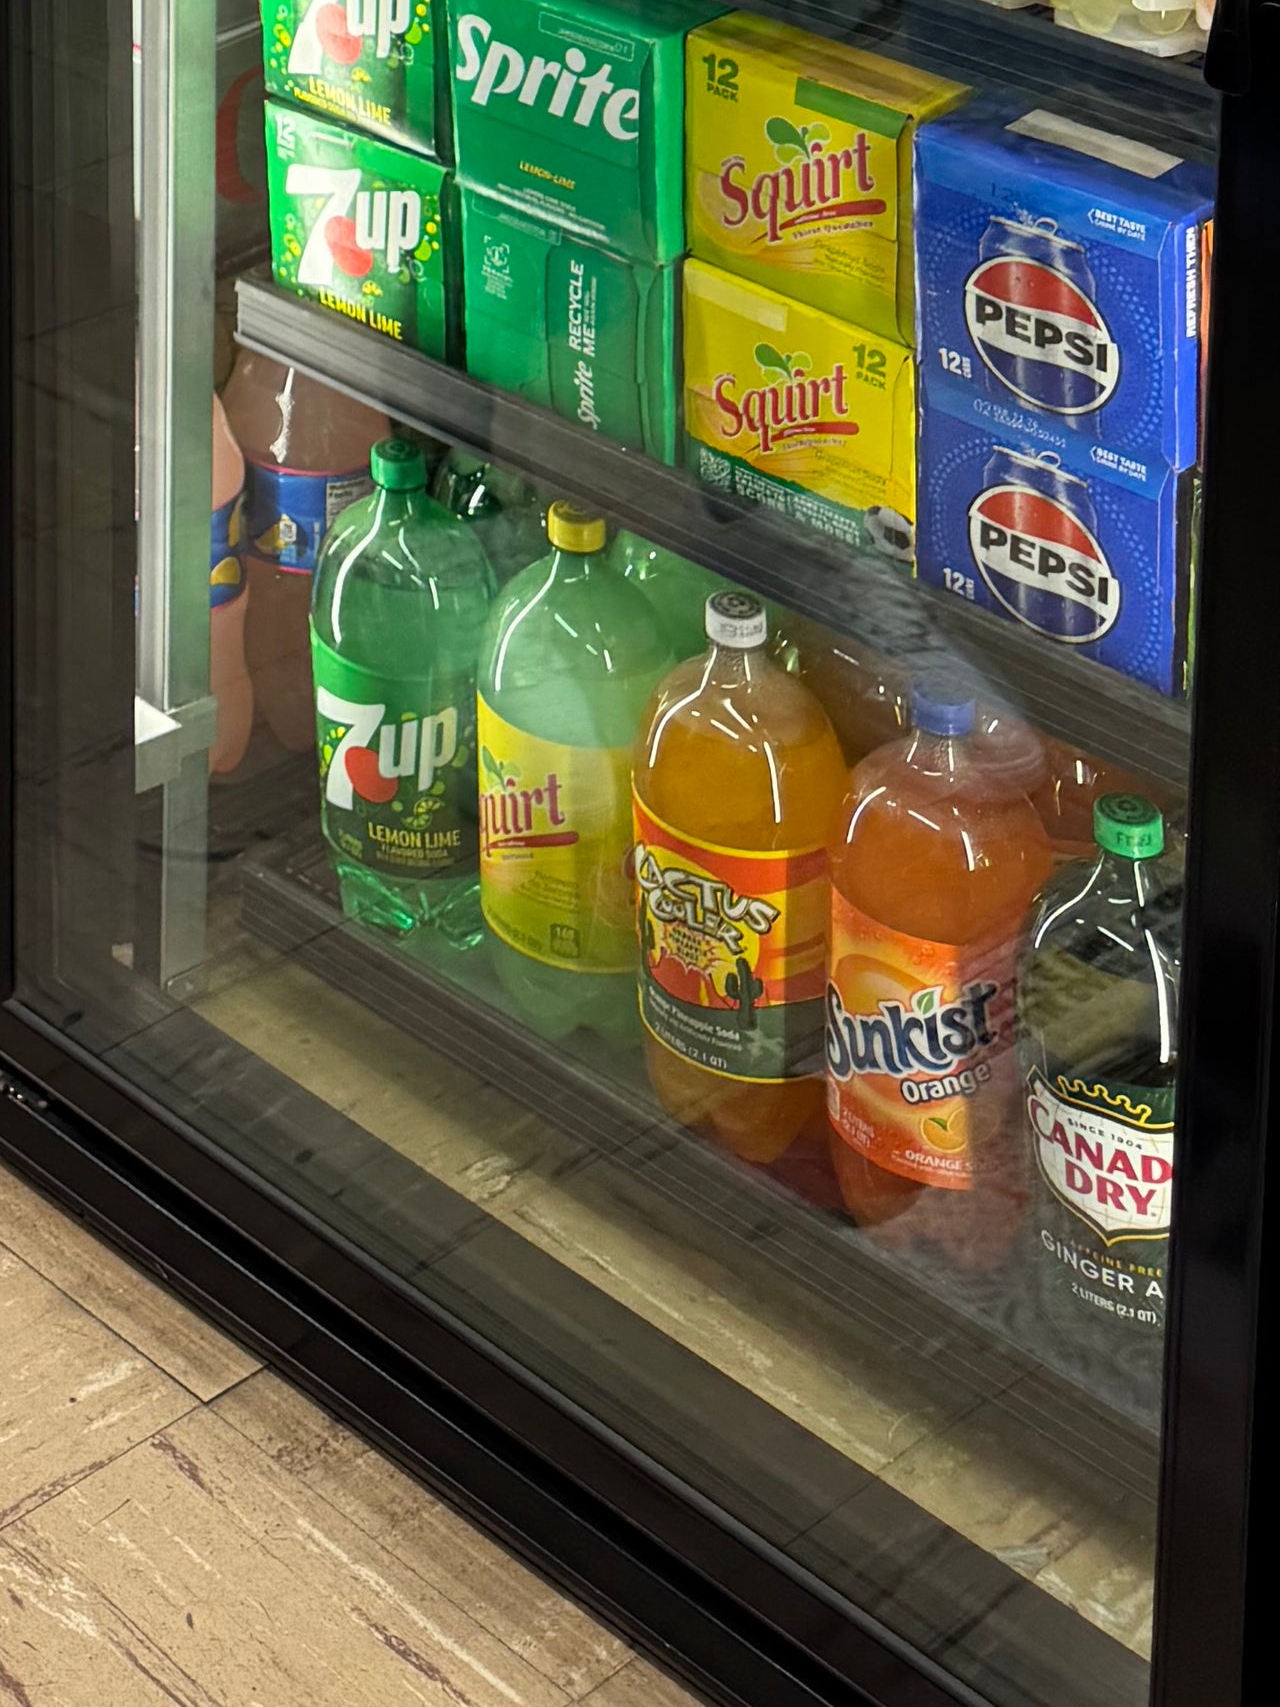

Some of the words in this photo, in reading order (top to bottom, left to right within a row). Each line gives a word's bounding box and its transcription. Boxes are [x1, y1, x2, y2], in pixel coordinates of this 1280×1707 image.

[455, 13, 639, 142] Sprite
[702, 52, 741, 90] 12
[706, 82, 739, 103] PACK
[308, 76, 354, 111] LEMON
[356, 96, 393, 127] LIME
[518, 159, 577, 191] LEMON-LIME
[720, 132, 874, 243] Squirt
[1093, 208, 1119, 226] BEST
[1120, 216, 1147, 234] TASTE
[1185, 227, 1197, 268] THEN
[319, 287, 368, 325] LEMON
[368, 307, 404, 341] LIME
[568, 260, 585, 351] RECYCLE
[1185, 269, 1197, 338] REFRESH
[582, 322, 597, 358] ME
[974, 295, 1109, 376] PEPSI
[852, 342, 888, 377] 12
[855, 367, 887, 391] PACK
[938, 346, 962, 375] 12
[714, 361, 849, 453] Squirt
[317, 687, 459, 812] 7up
[368, 821, 421, 848] LEMON
[424, 827, 461, 849] LIME
[824, 981, 998, 1083] Sunkist
[900, 1058, 991, 1105] Orange
[1027, 1093, 1174, 1187] CANAD
[1066, 1117, 1108, 1141] SINCE
[1109, 1131, 1144, 1152] 1904
[904, 1148, 963, 1172] ORANGE
[1040, 1228, 1140, 1297] GINGER
[1128, 1260, 1164, 1279] FREE
